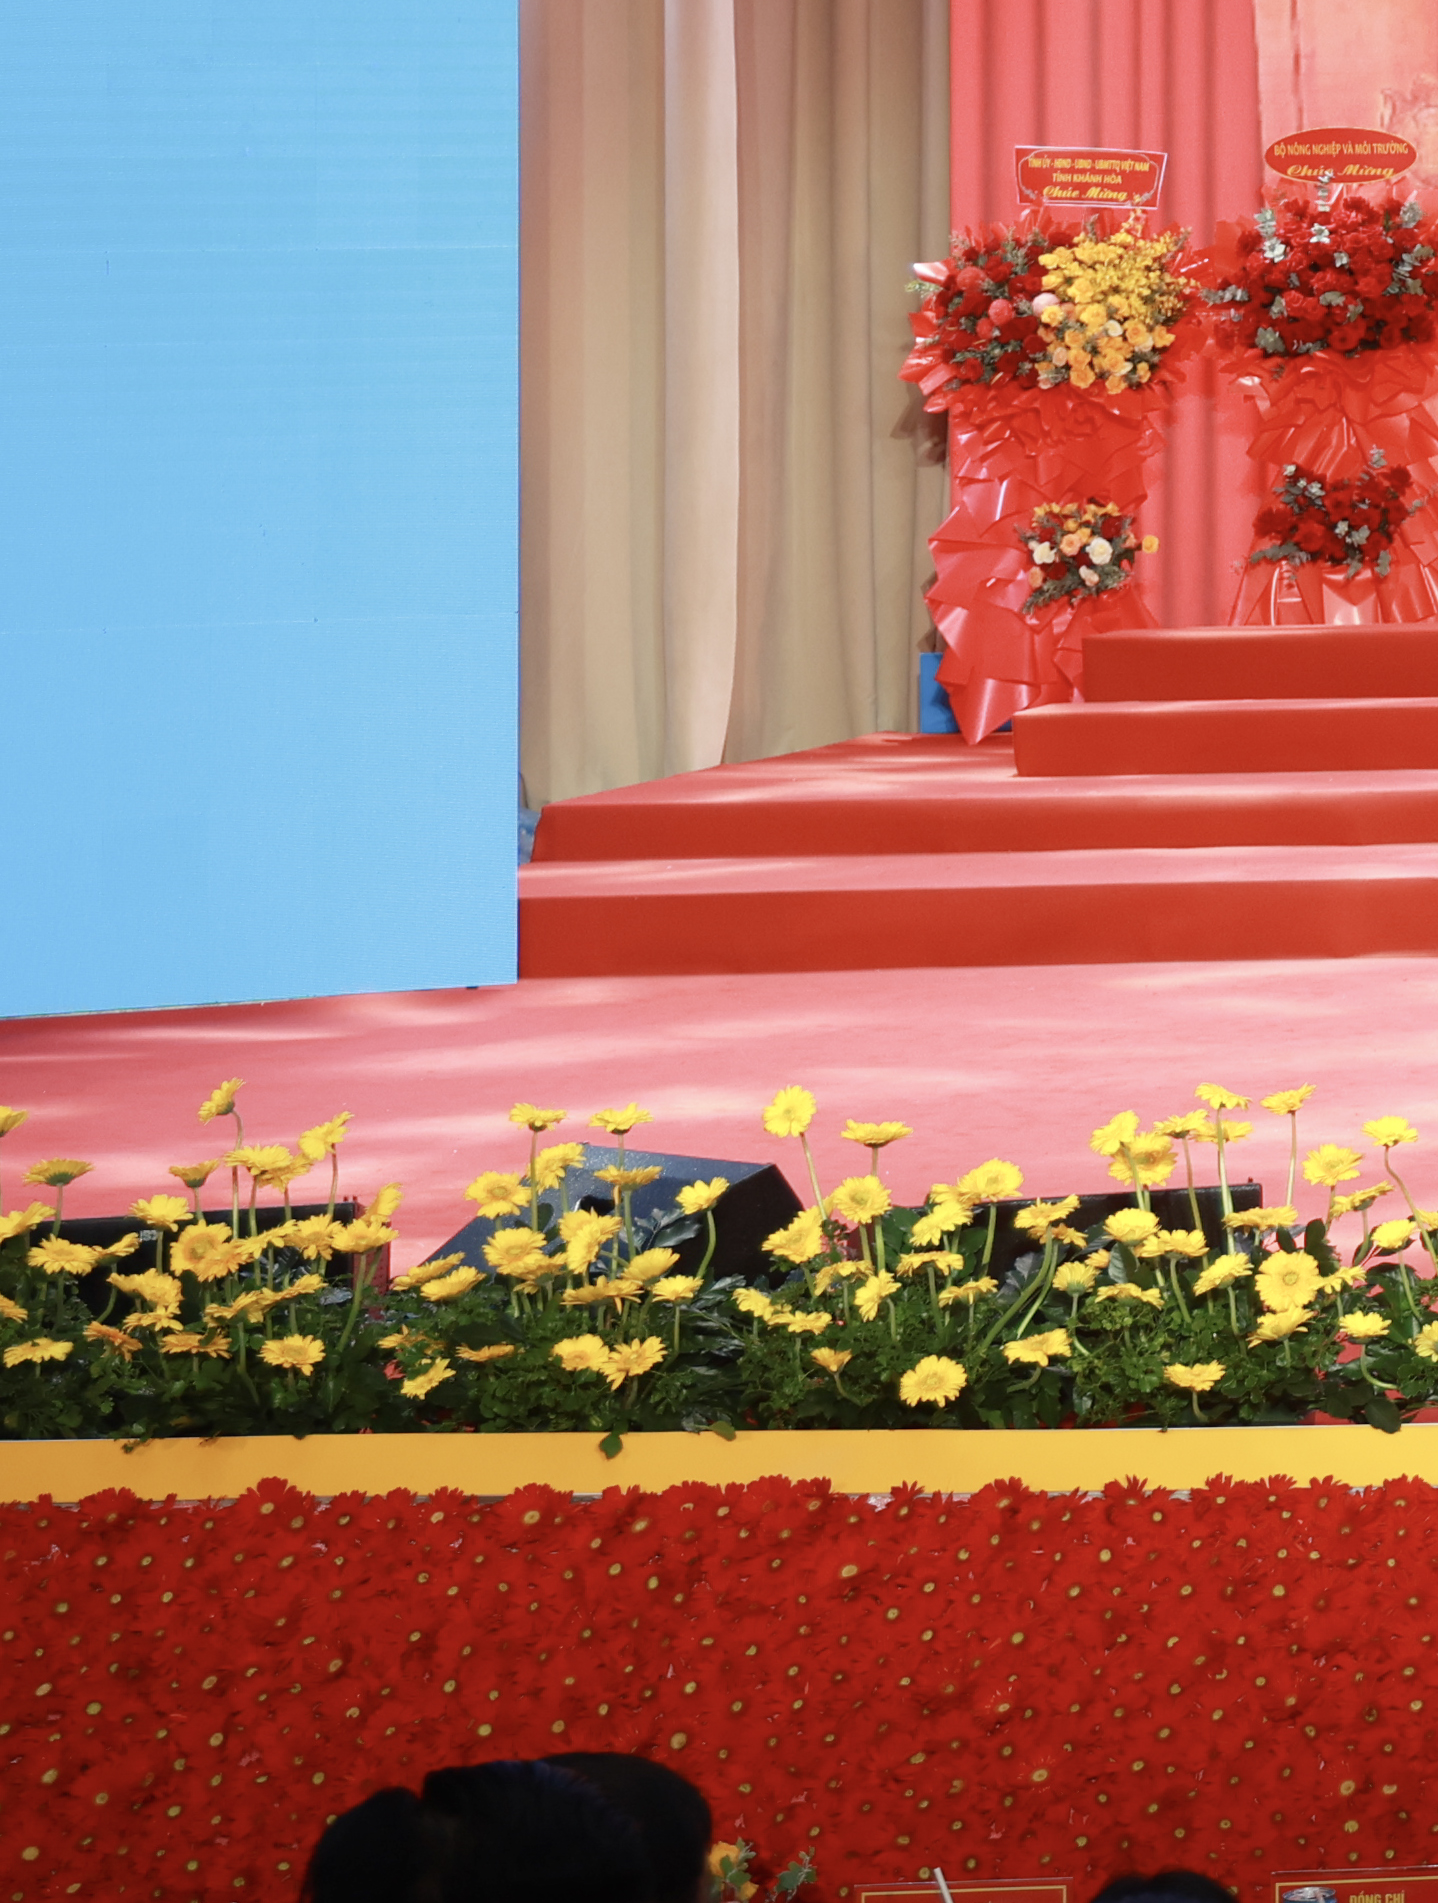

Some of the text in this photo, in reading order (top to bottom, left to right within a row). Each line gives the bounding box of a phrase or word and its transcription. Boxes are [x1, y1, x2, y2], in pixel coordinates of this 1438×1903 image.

[1288, 141, 1311, 156] NÔNG
[1312, 141, 1341, 157] NGHIỆP
[1343, 141, 1354, 155] VÀ
[1355, 140, 1371, 155] MÔI
[1372, 140, 1409, 154] TRƯỜNG
[1287, 164, 1394, 179] Chúc Mừng
[1043, 185, 1128, 201] Chúc Mừng
